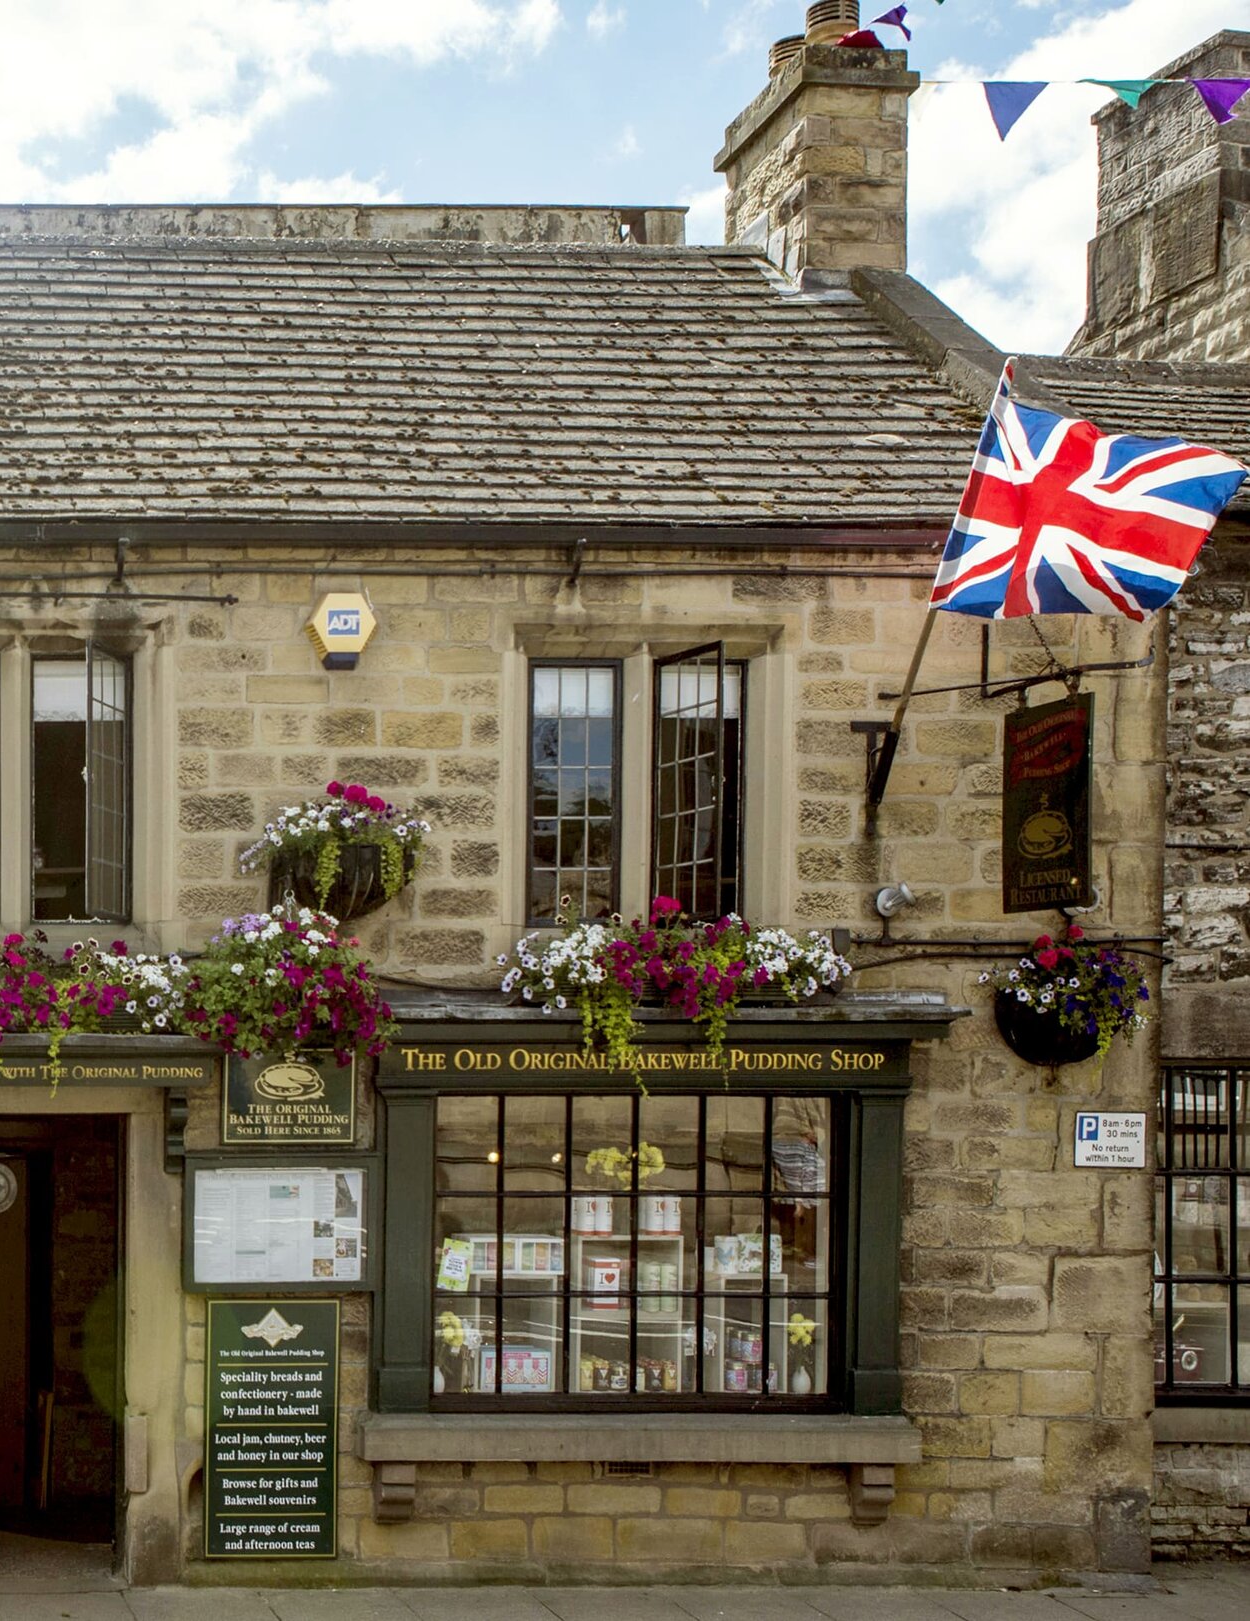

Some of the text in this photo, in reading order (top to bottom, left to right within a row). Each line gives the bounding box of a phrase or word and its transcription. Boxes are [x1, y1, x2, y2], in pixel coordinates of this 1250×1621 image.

[328, 614, 360, 631] ADT
[1019, 869, 1071, 888] LICENSED
[1010, 885, 1083, 908] RESTAURANT
[401, 1048, 446, 1071] THE
[454, 1049, 501, 1071] OLD
[729, 1049, 823, 1071] PUDDING
[830, 1049, 885, 1071] SHOP
[72, 1065, 138, 1080] ORIGINAL
[142, 1065, 204, 1079] PUDDING
[1082, 1118, 1097, 1139] P
[1106, 1130, 1138, 1138] 30 mins
[1091, 1144, 1104, 1152] No
[1117, 1155, 1135, 1163] hour
[241, 1350, 264, 1358] Original
[220, 1371, 322, 1385] Speciality breads and
[220, 1388, 288, 1402] confectionery
[296, 1388, 322, 1399] made
[223, 1405, 319, 1418] by hand in bakewell
[215, 1433, 327, 1447] Local jam, chutney, beer
[217, 1450, 324, 1463] and honey in our shop
[222, 1478, 318, 1492] Browse for gifts and
[224, 1495, 317, 1506] Bakewell souvenirs
[220, 1522, 320, 1535] Large range of cream
[225, 1539, 315, 1550] and afternoon teas
